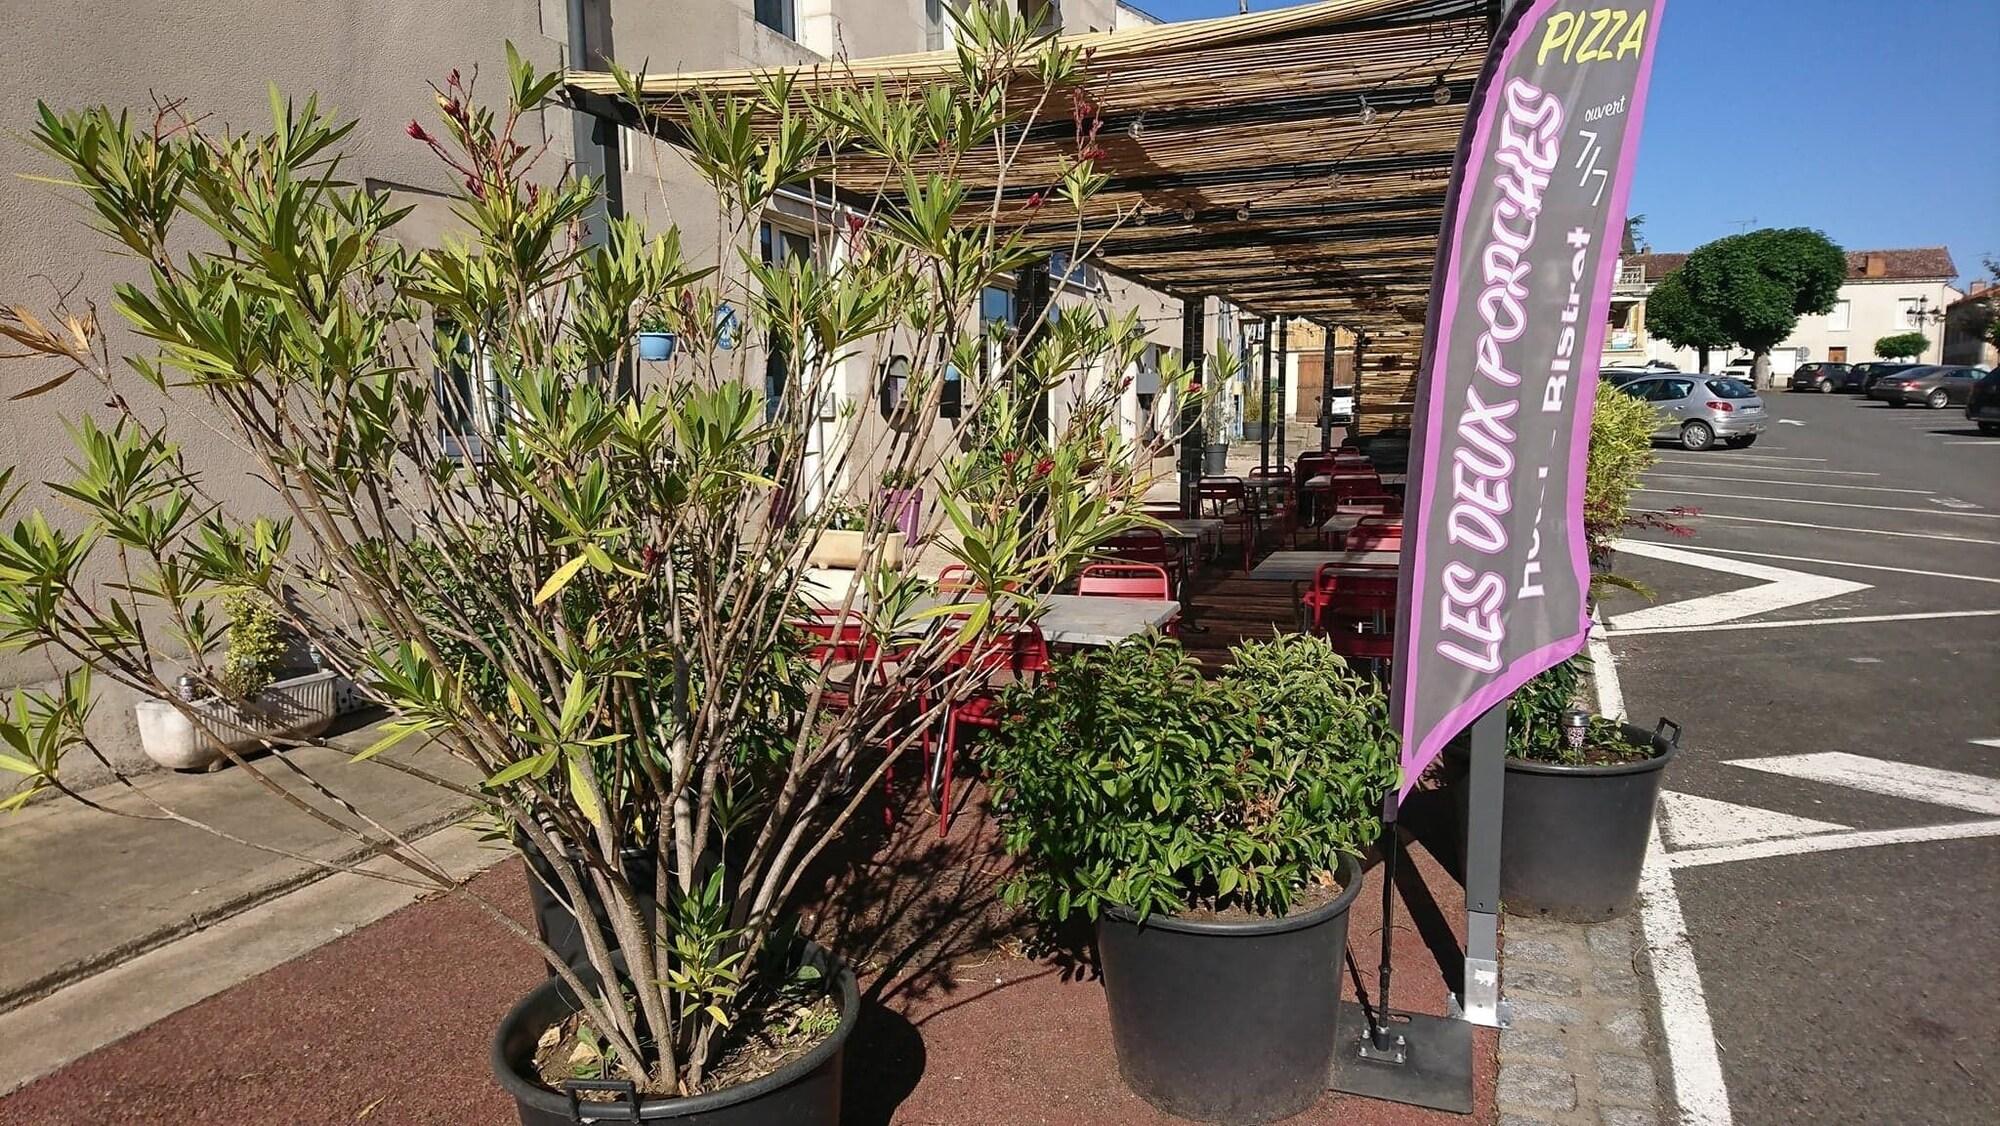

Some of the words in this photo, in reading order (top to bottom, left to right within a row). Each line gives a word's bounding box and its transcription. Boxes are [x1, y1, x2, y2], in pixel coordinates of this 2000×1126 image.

[1537, 8, 1647, 66] PIZZA
[1584, 95, 1626, 123] ouvert
[1575, 130, 1608, 207] 7/7
[1476, 76, 1564, 387] PORCHES
[1447, 385, 1519, 554] DEUX
[1437, 560, 1505, 673] LES
